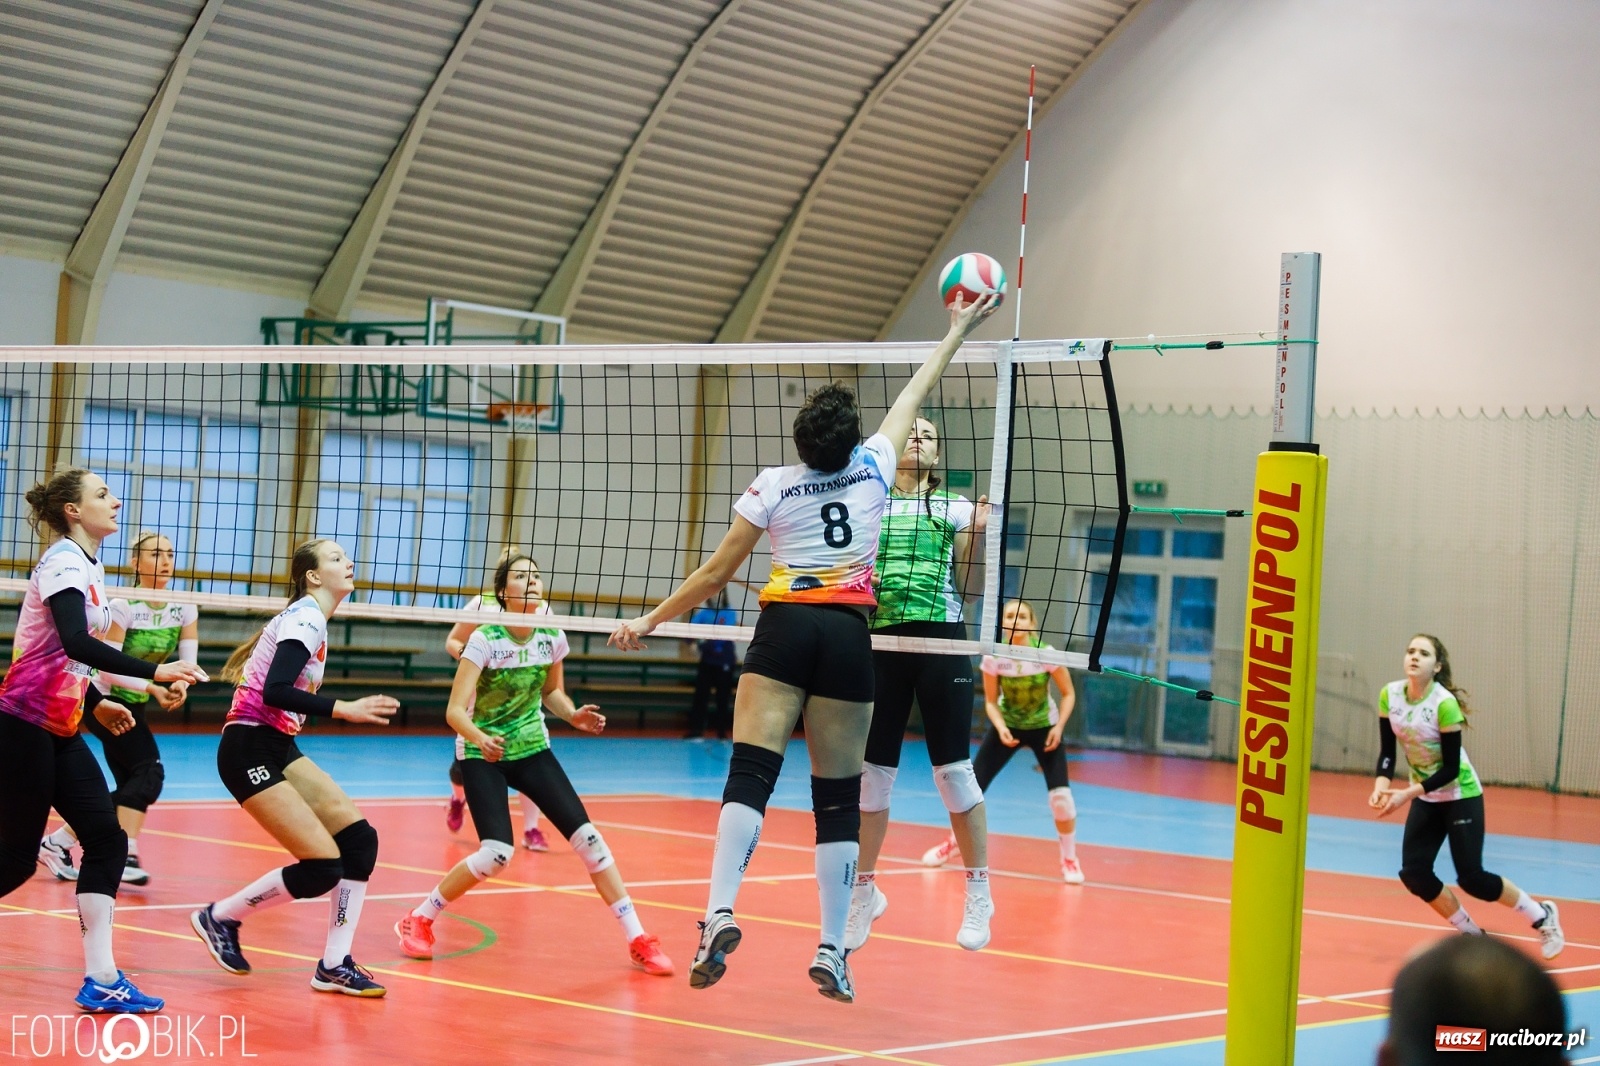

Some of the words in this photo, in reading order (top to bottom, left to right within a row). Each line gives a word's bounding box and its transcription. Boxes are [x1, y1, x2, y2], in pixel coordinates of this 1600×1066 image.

[1279, 272, 1291, 409] PESMENPOL
[780, 484, 802, 500] UKS
[804, 467, 874, 496] KRZANOWICE
[901, 502, 910, 514] 1
[820, 501, 853, 549] 8
[152, 613, 163, 626] 17
[517, 648, 529, 664] 11
[1240, 482, 1302, 834] PESMENPOL
[247, 765, 271, 785] 55
